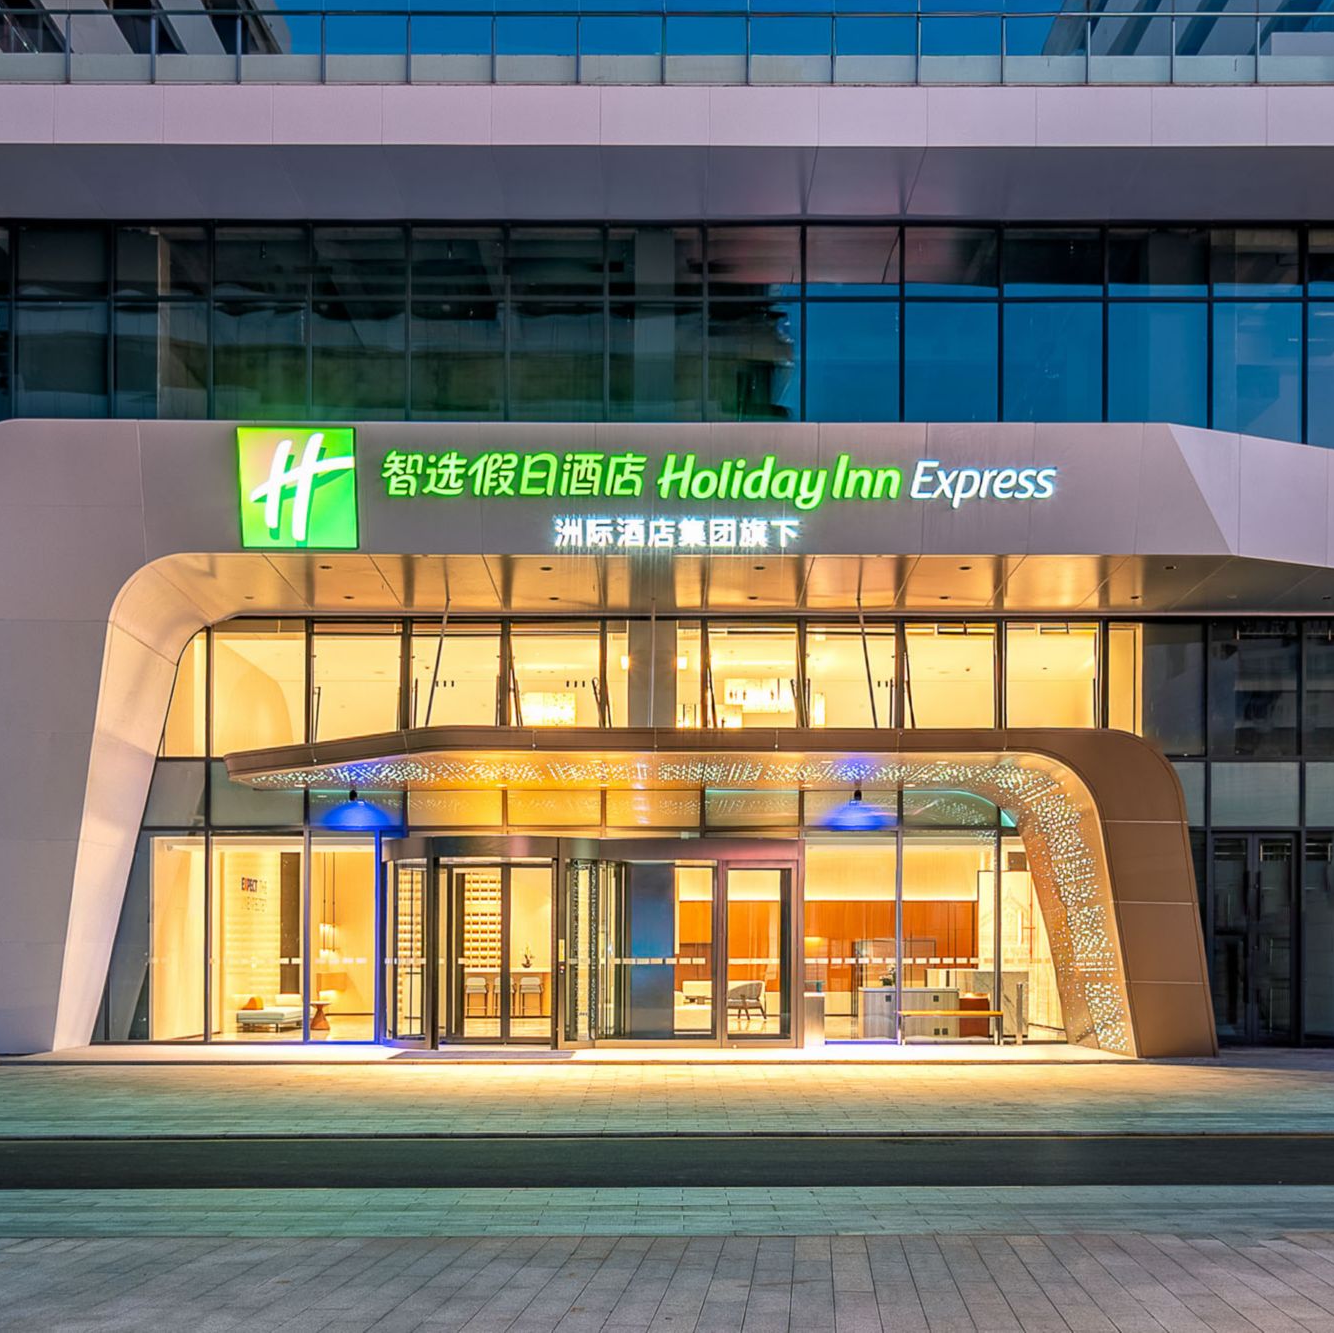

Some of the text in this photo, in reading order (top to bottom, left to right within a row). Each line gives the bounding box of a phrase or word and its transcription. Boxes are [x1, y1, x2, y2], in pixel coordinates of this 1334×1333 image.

[381, 449, 1058, 511] 智选假日酒店 Holiday Inn Express
[553, 516, 801, 548] 洲际酒店集团旗下
